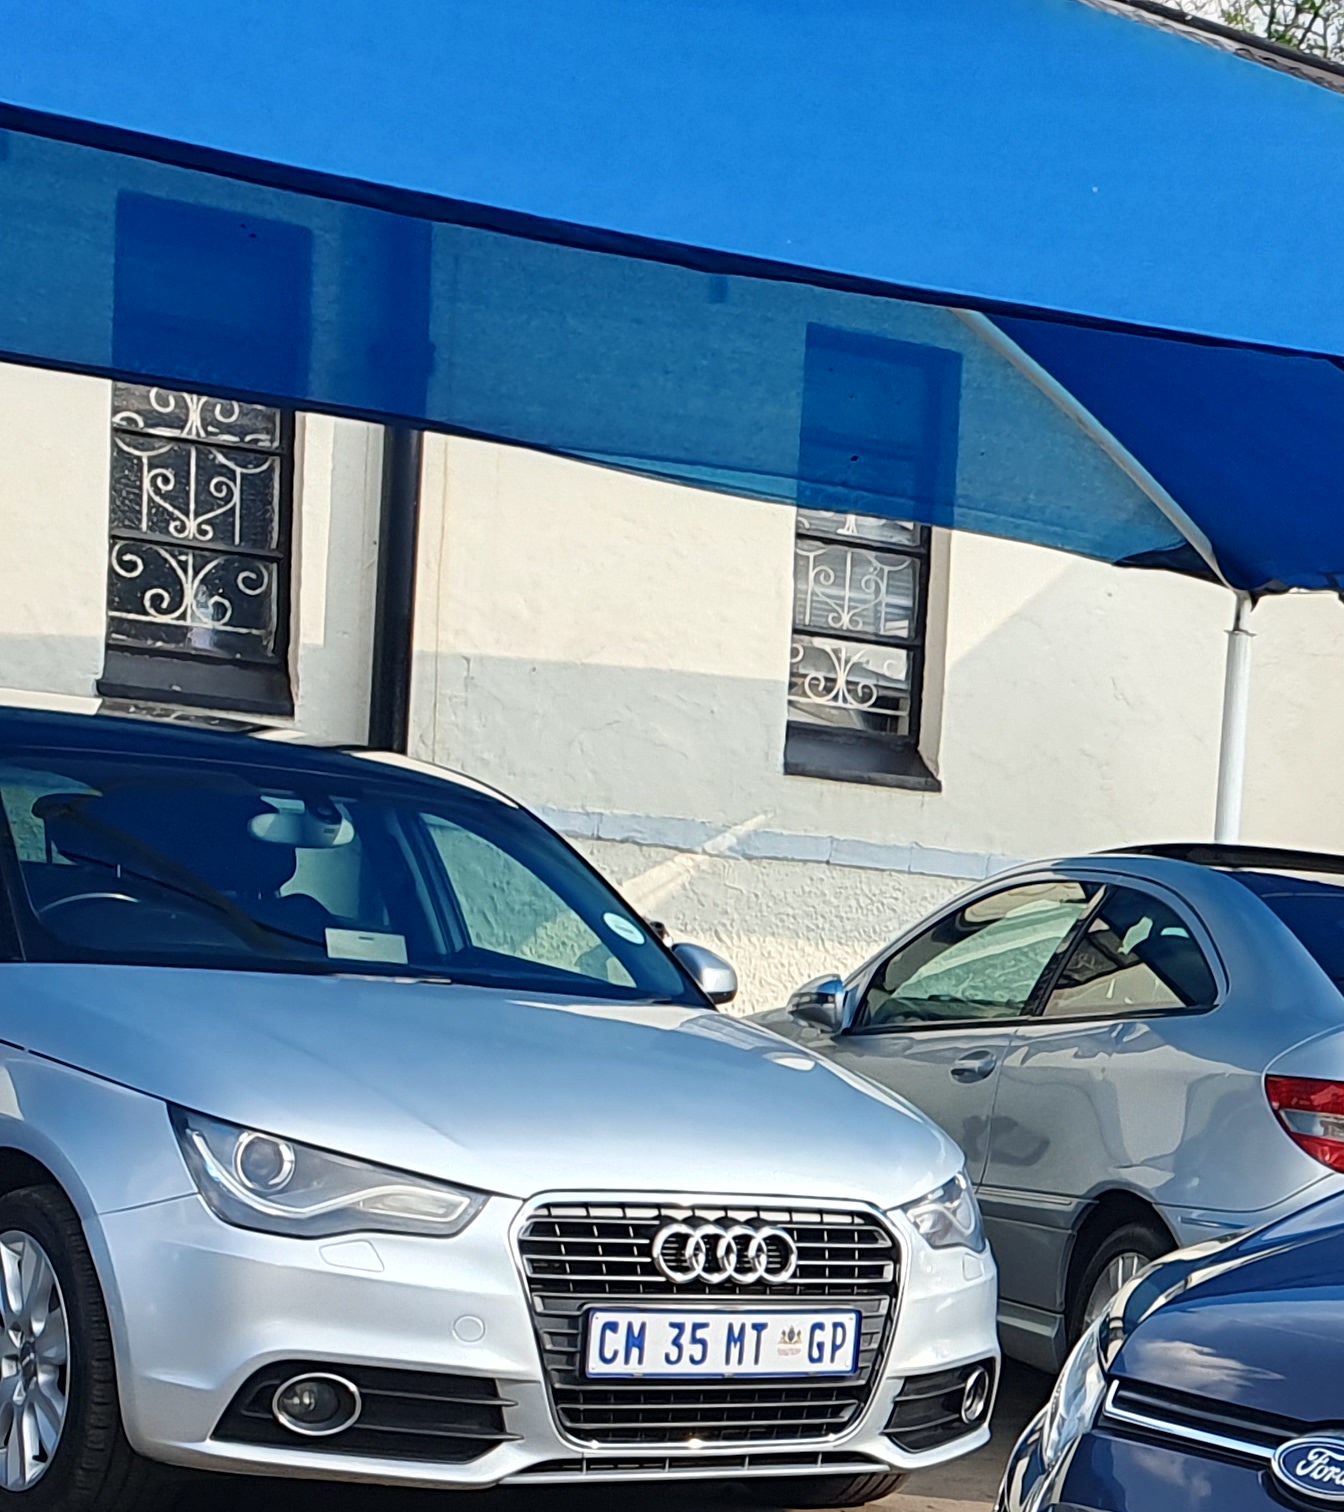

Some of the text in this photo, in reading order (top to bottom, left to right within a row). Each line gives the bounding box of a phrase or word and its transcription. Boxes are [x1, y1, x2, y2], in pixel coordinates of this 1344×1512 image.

[598, 1321, 847, 1366] CM 35 MT GP
